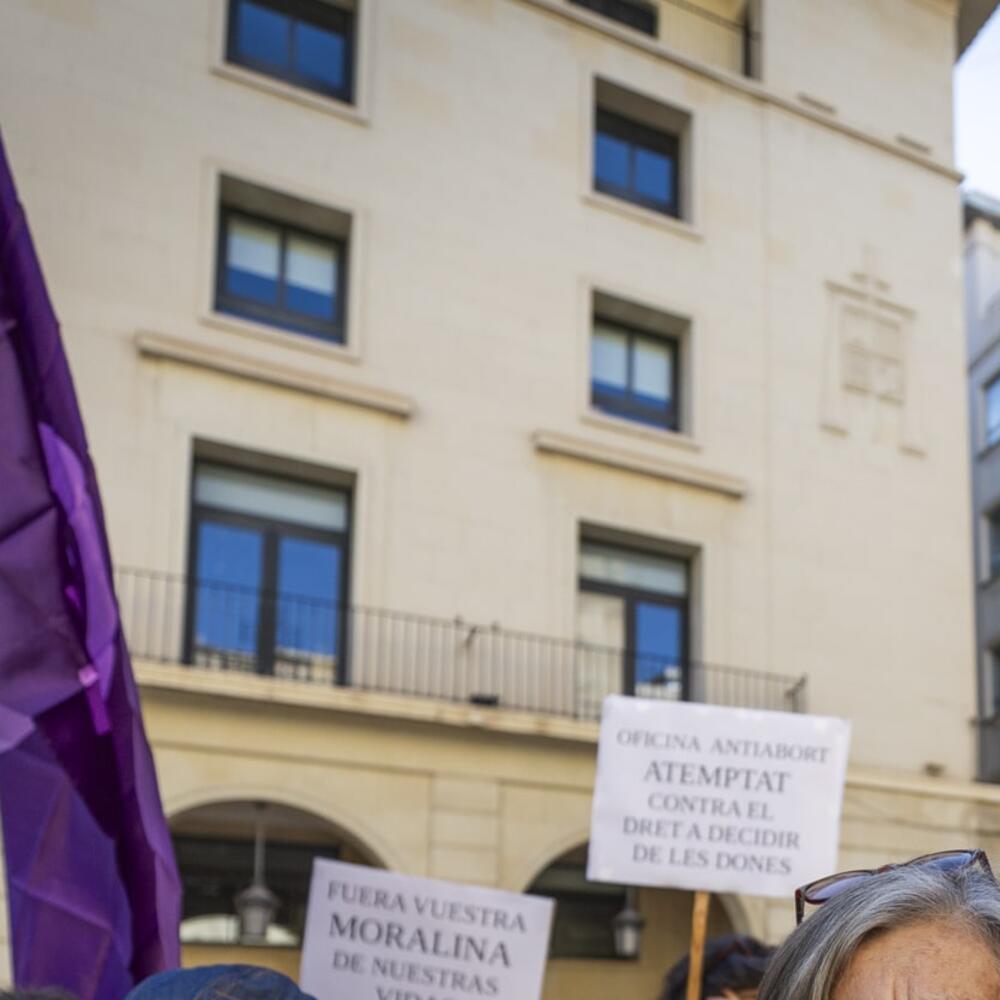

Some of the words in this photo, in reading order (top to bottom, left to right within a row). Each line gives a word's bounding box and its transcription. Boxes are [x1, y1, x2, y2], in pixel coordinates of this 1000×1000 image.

[616, 729, 700, 752] OFICINA
[711, 737, 830, 763] ANTIABORT
[643, 760, 791, 793] ATEMPTAT
[648, 792, 741, 818] CONTRA
[746, 802, 775, 820] EL
[623, 816, 683, 839] DRET
[687, 824, 703, 841] A
[709, 825, 800, 850] DECIDIR
[632, 844, 664, 863] DE
[668, 850, 708, 868] LES
[715, 853, 791, 875] DONES
[328, 880, 407, 914] FUERA
[413, 894, 527, 933] VUESTRA
[329, 911, 512, 969] MORALINA
[332, 951, 366, 974] DE
[371, 956, 499, 996] NUESTRAS
